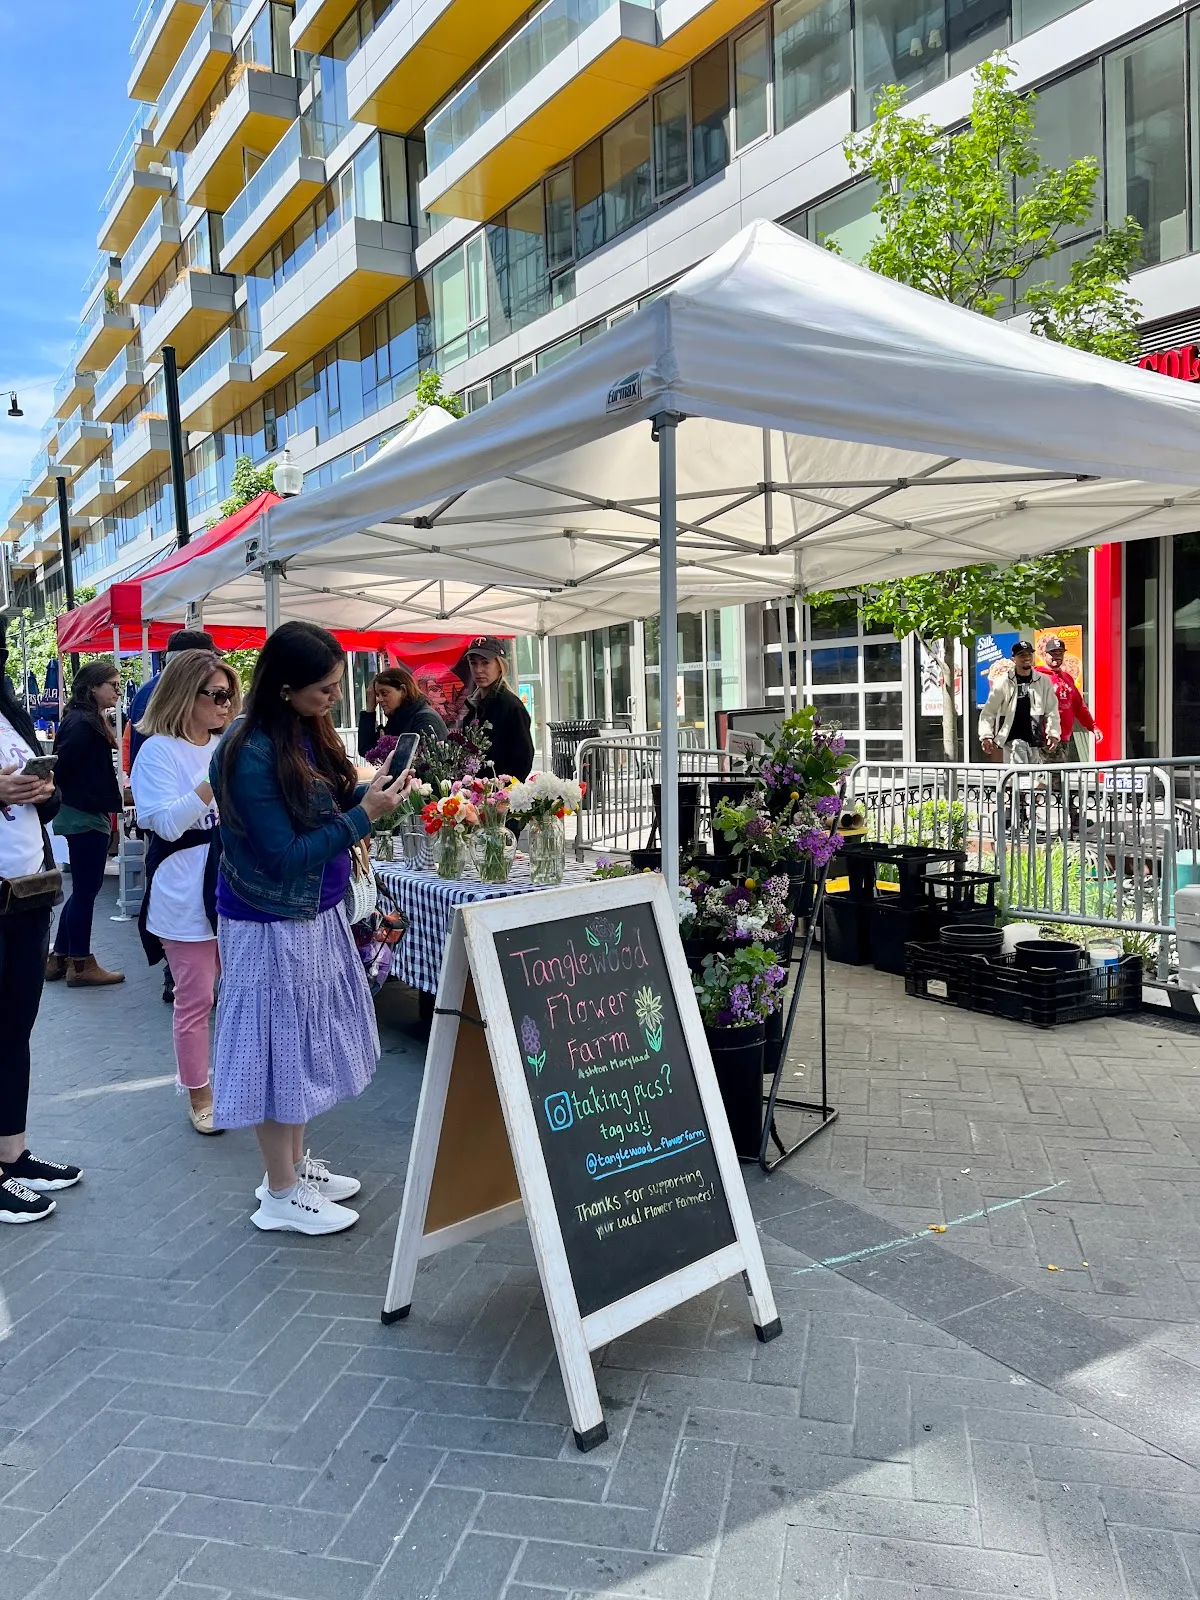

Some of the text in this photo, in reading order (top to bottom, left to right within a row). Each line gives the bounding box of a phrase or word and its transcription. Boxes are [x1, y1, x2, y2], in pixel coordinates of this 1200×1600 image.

[977, 635, 995, 650] Silk
[509, 927, 649, 987] Tanglewood
[547, 989, 628, 1030] Flower
[567, 1031, 630, 1070] Farm
[577, 1049, 650, 1079] Ashton Maryland
[571, 1063, 673, 1119] taking pics?
[600, 1123, 625, 1143] tag
[1, 1178, 42, 1203] MOSCHINO
[574, 1195, 622, 1222] Thanks
[647, 1169, 705, 1196] supporting
[644, 1200, 673, 1220] Flower
